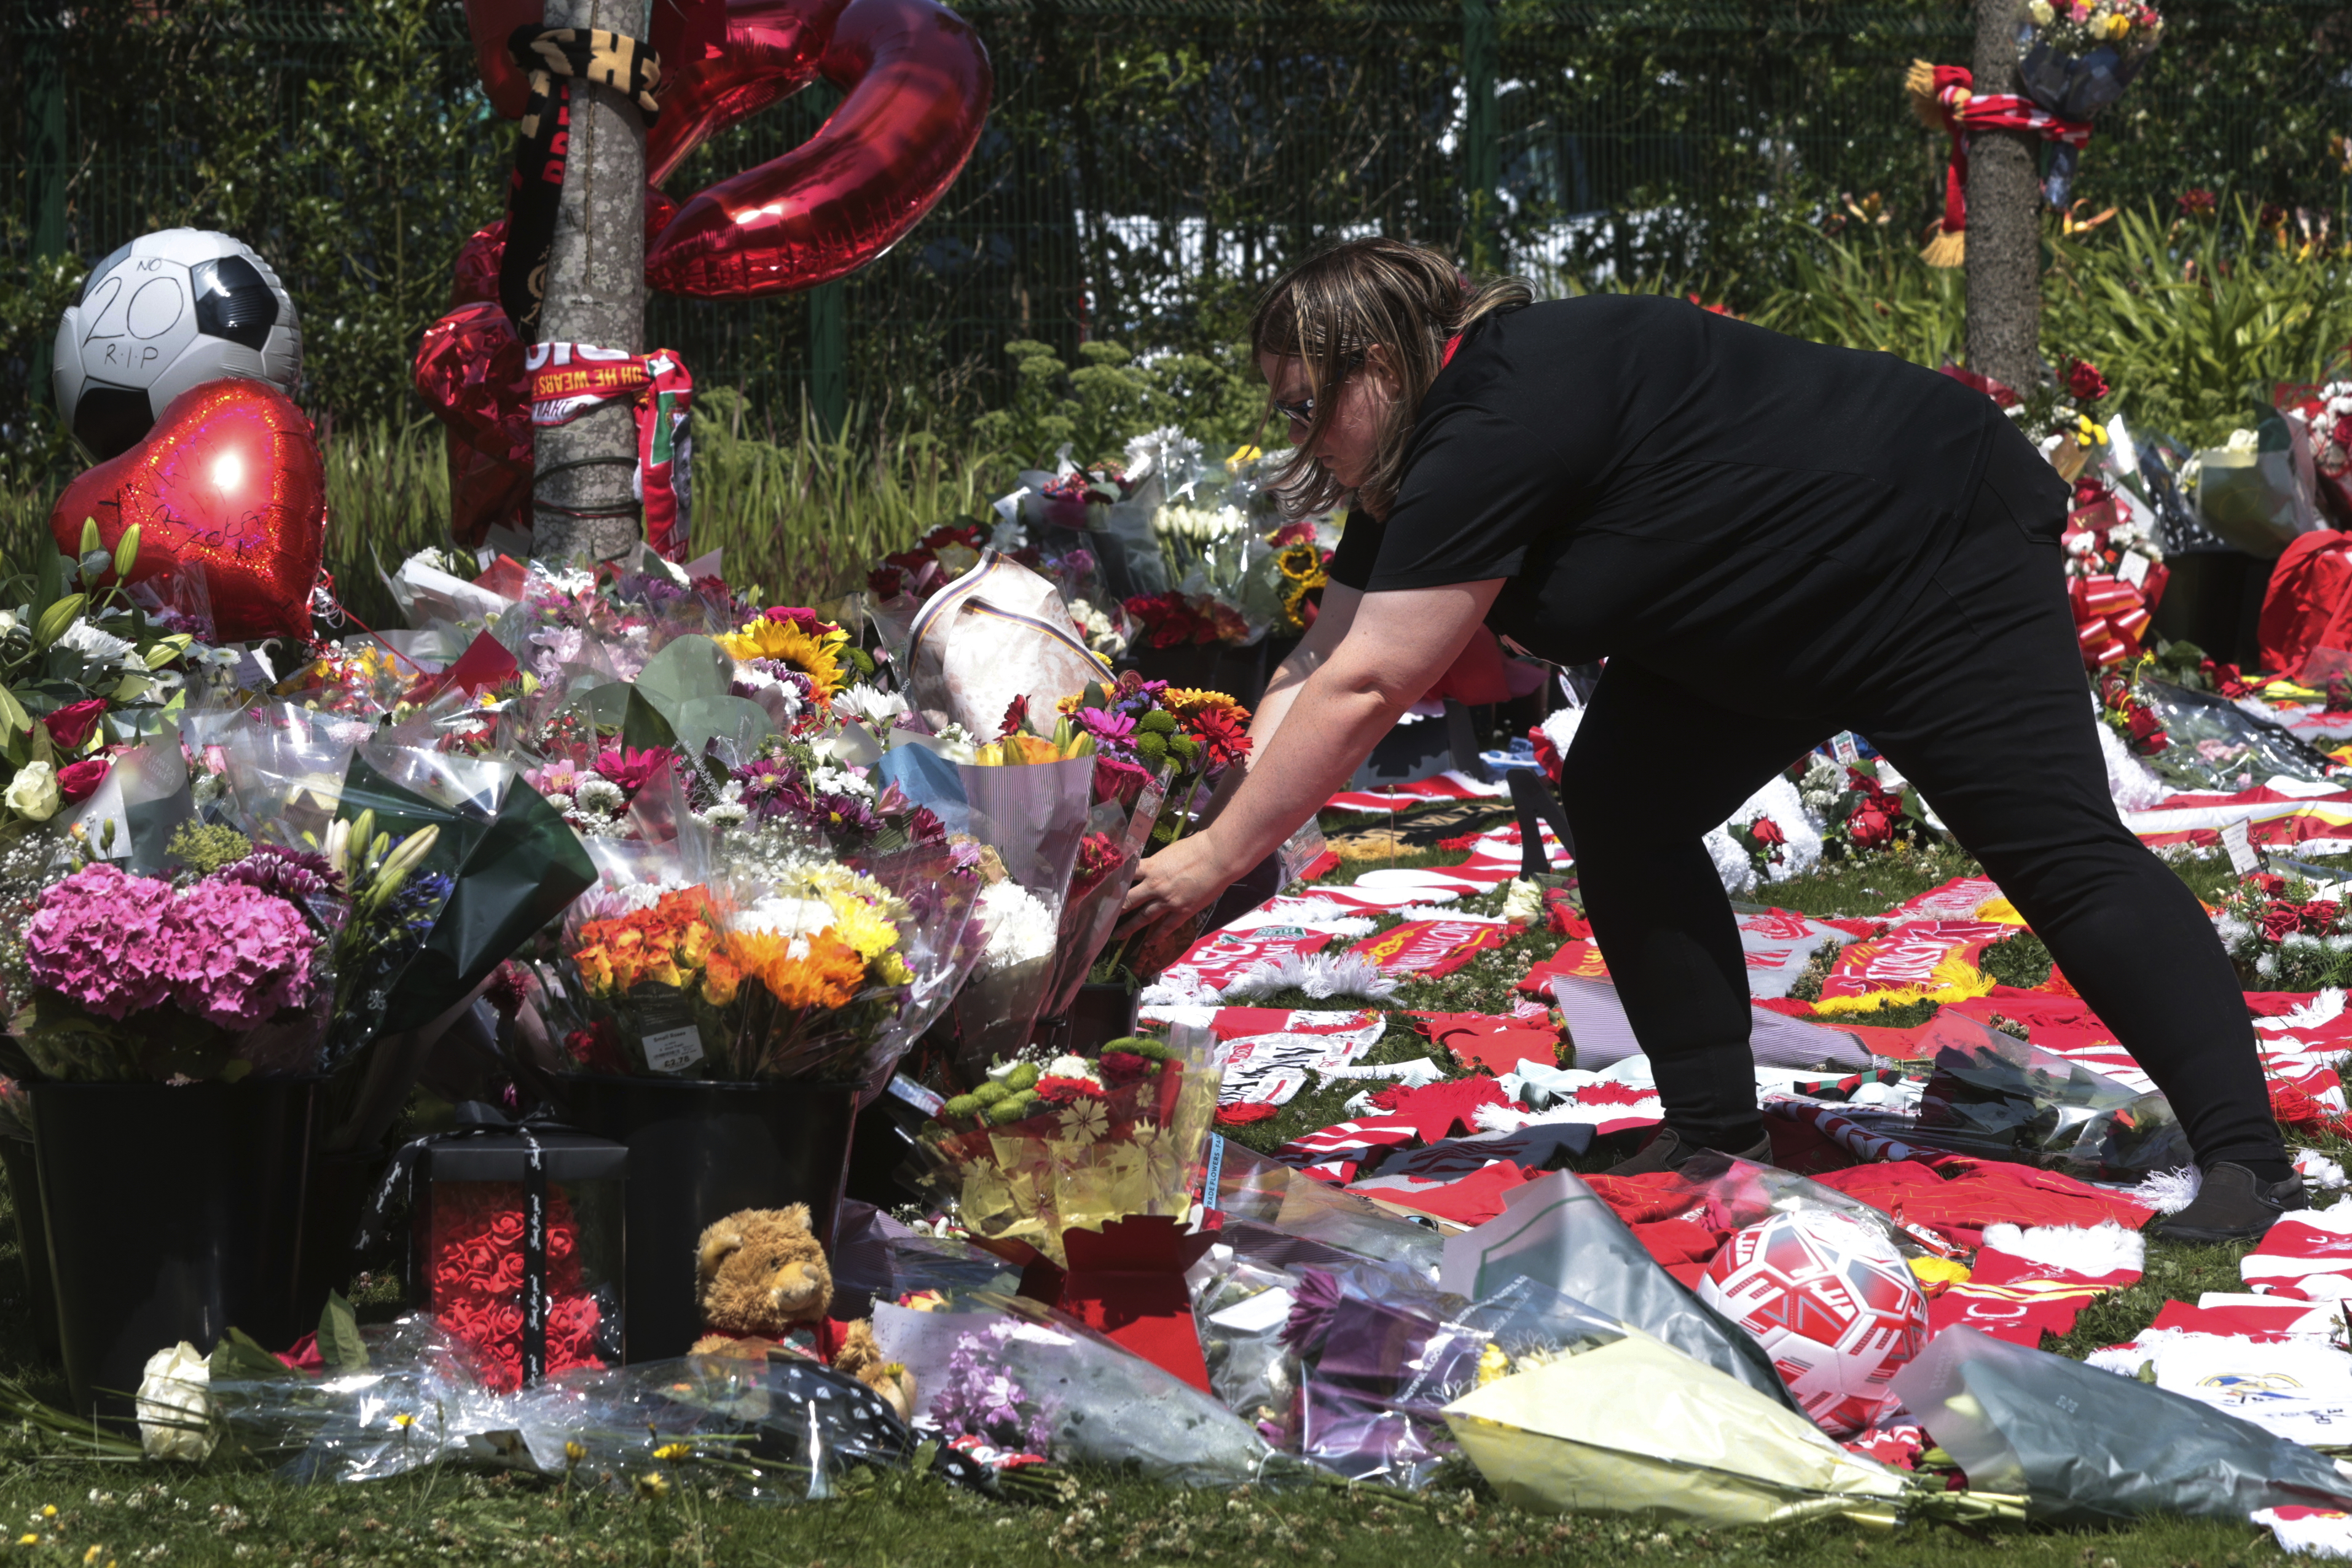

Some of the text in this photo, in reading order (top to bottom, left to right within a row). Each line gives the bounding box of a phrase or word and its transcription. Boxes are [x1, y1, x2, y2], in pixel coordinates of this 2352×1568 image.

[136, 259, 162, 271] NO
[82, 276, 184, 348] 20
[539, 370, 590, 394] WEARS
[594, 368, 617, 387] HE
[936, 827, 963, 841] BLOOMS
[1210, 1152, 1220, 1185] FLOWERS
